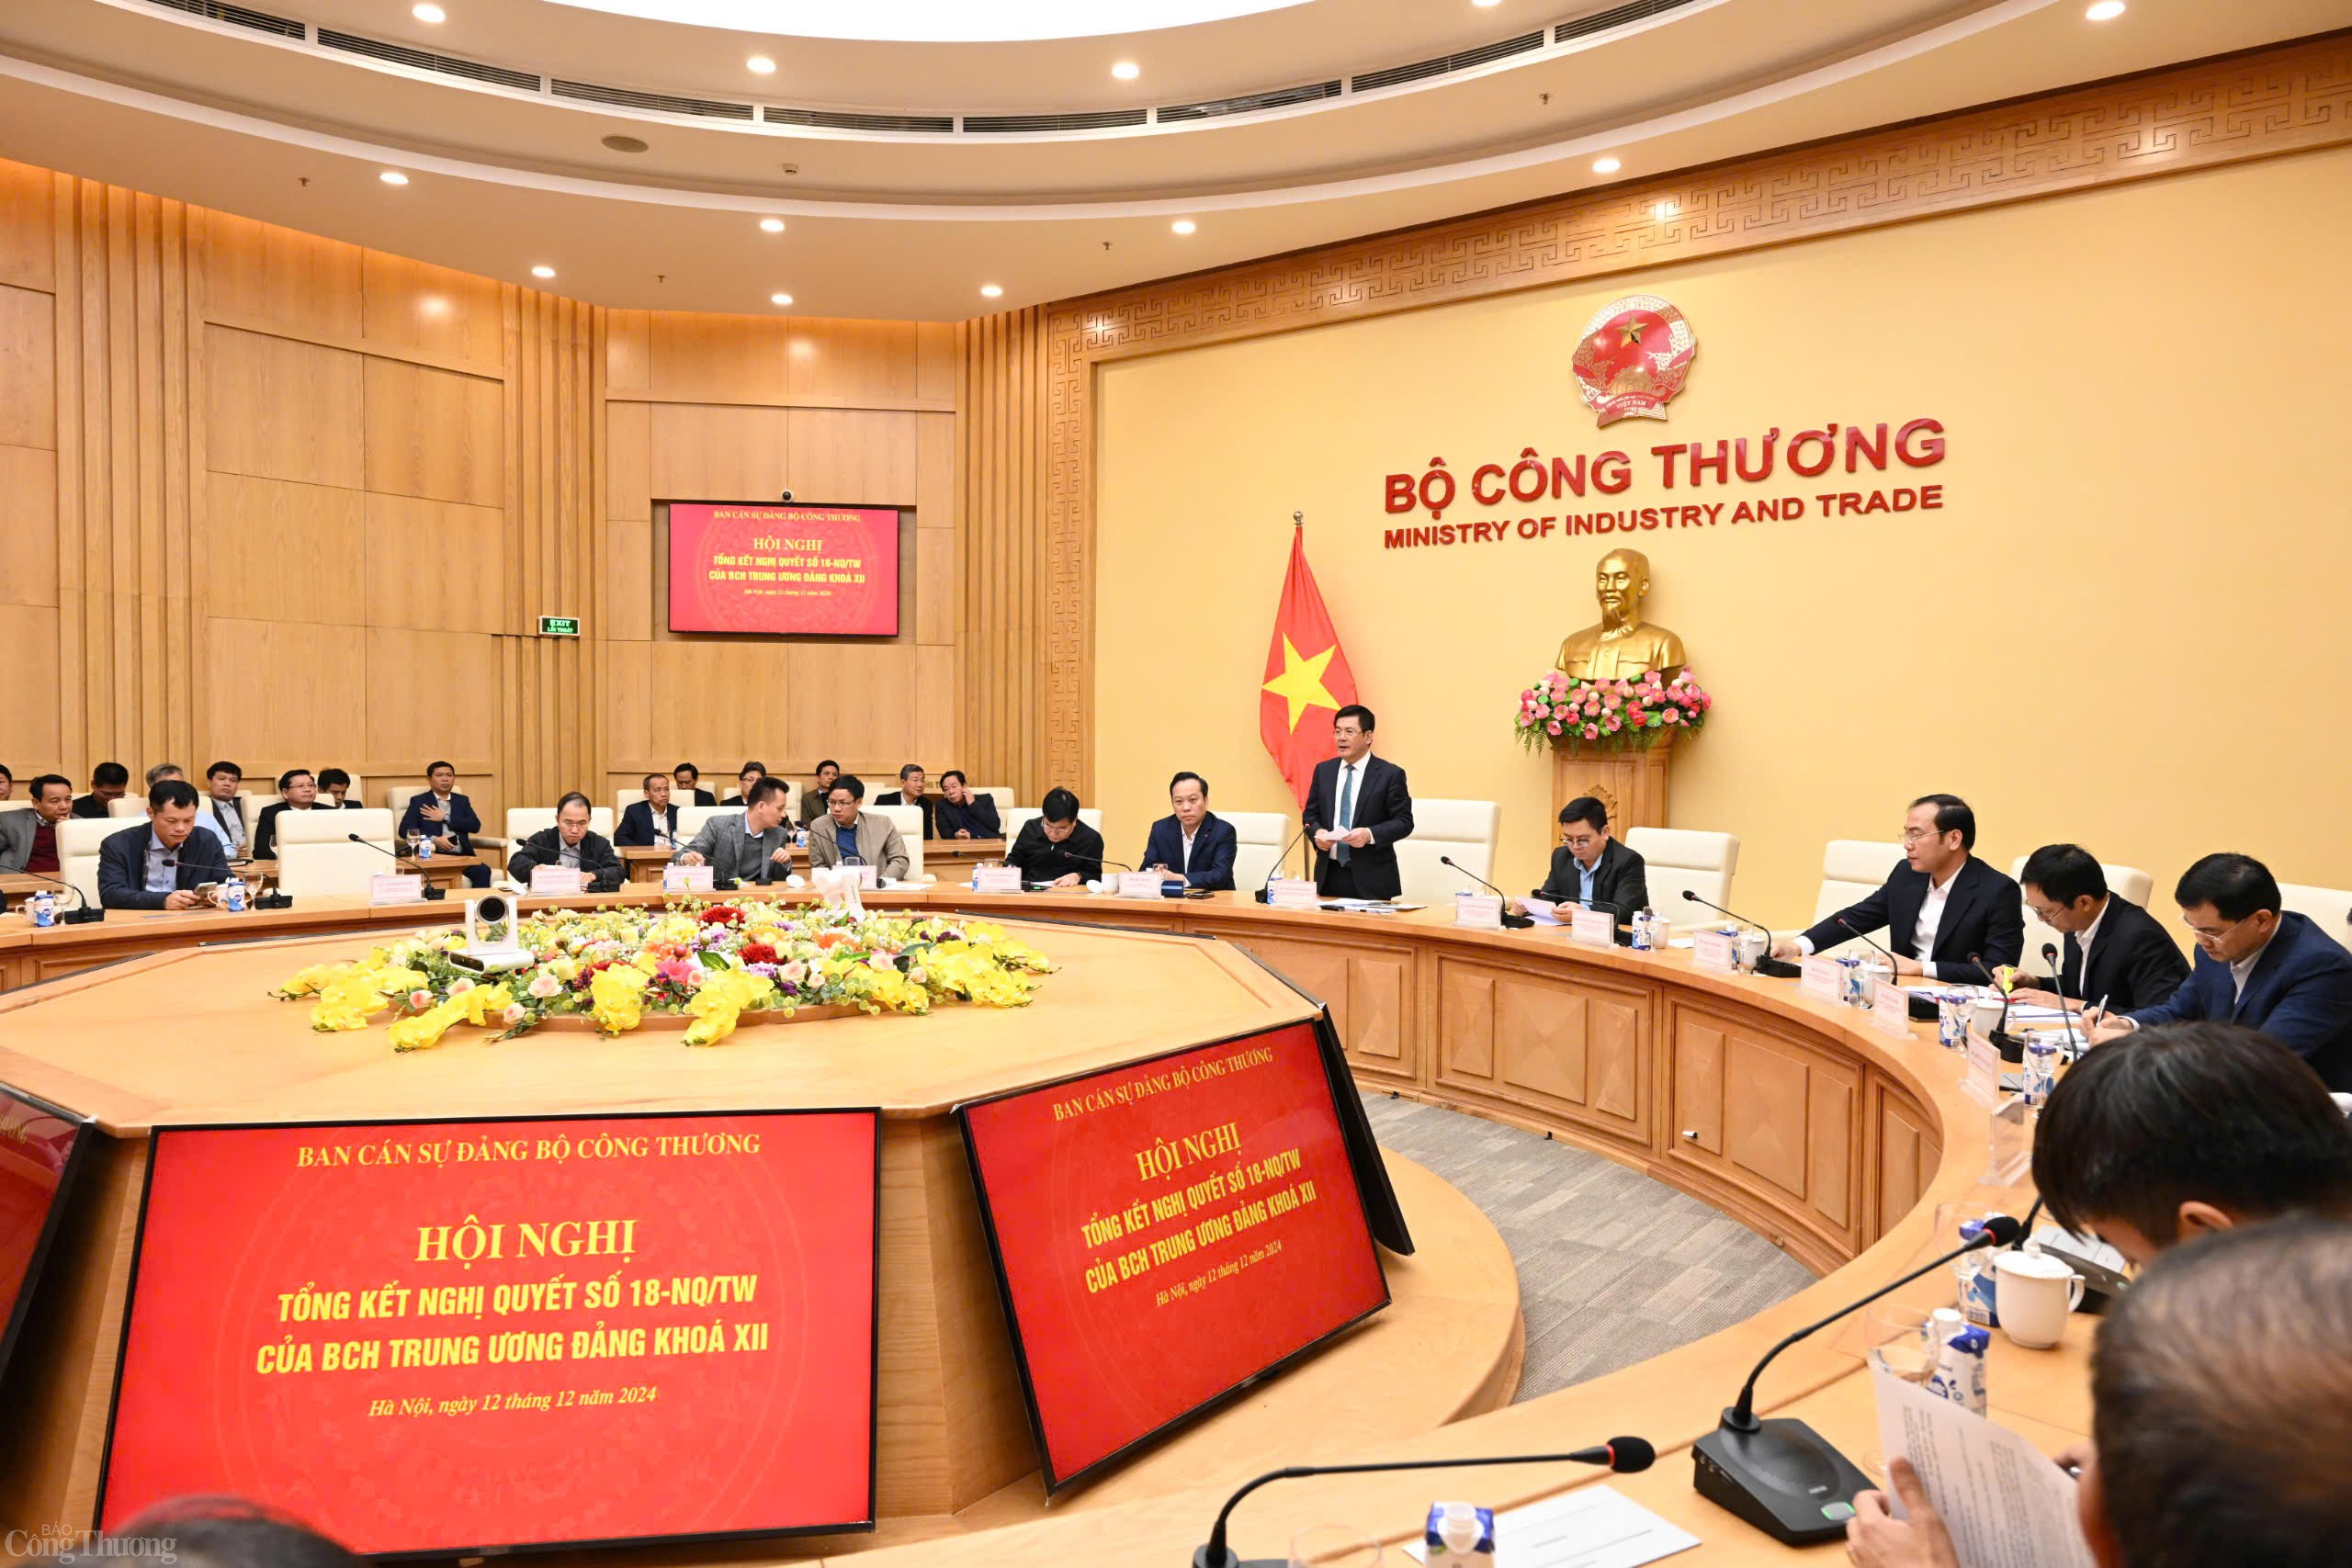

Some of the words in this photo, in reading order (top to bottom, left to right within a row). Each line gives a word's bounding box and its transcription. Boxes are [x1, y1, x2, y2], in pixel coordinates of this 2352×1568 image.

[1385, 457, 1455, 519] BỘ
[1471, 446, 1632, 505] CÔNG
[1650, 418, 1945, 488] THƯƠNG
[1384, 520, 1510, 548] MINISTRY
[1517, 515, 1556, 538] OF
[1566, 502, 1724, 536] INDUSTRY
[1731, 496, 1804, 523] AND
[1815, 484, 1942, 516] TRADE
[713, 553, 736, 565] TỔNG
[738, 554, 753, 566] KẾT
[755, 557, 776, 567] NGHỊ
[778, 555, 805, 567] QUYẾT
[806, 556, 819, 568] SỐ
[820, 558, 861, 569] 18-NQ/TW
[753, 535, 781, 552] HỘI
[784, 538, 823, 555] NGHỊ
[708, 569, 727, 580] CỦA
[728, 570, 746, 581] BCH
[748, 570, 776, 581] TRUNG
[777, 571, 802, 581] ƯƠNG
[803, 570, 827, 582] ĐẢNG
[829, 573, 852, 583] KHOÁ
[854, 573, 865, 583] XII
[1052, 1097, 1084, 1122] BAN
[1084, 1088, 1114, 1111] CÁN
[1114, 1081, 1133, 1105] SỰ
[1134, 1074, 1171, 1099] ĐẢNG
[1171, 1065, 1191, 1089] BỘ
[1191, 1059, 1226, 1082] CÔNG
[1225, 1047, 1272, 1072] THƯƠNG
[298, 1145, 351, 1167] BAN
[357, 1138, 412, 1166] CÁN
[417, 1139, 452, 1168] SỰ
[457, 1135, 528, 1162] ĐẢNG
[536, 1134, 571, 1165] BỘ
[577, 1133, 648, 1158] CÔNG
[655, 1132, 760, 1156] THƯƠNG
[1135, 1137, 1183, 1181] HỘI
[1182, 1122, 1241, 1165] NGHỊ
[1080, 1213, 1124, 1249] TỔNG
[1122, 1198, 1150, 1234] KẾT
[1150, 1190, 1188, 1223] NGHỊ
[1186, 1170, 1227, 1210] QUYẾT
[1227, 1162, 1246, 1193] SỐ
[1245, 1147, 1301, 1186] 18-NQ/TW
[414, 1213, 505, 1269] HỘI
[515, 1219, 638, 1264] NGHỊ
[1084, 1257, 1119, 1293] CỦA
[1116, 1247, 1150, 1280] BCH
[1148, 1228, 1196, 1266] TRUNG
[1194, 1213, 1234, 1247] ƯƠNG
[1231, 1200, 1268, 1232] ĐẢNG
[1266, 1183, 1300, 1217] KHOÁ
[1298, 1180, 1317, 1204] XII
[277, 1281, 351, 1322] TỔNG
[357, 1280, 412, 1319] KẾT
[417, 1285, 484, 1320] NGHỊ
[492, 1273, 578, 1316] QUYẾT
[583, 1269, 622, 1309] SỐ
[629, 1274, 758, 1307] 18-NQ/TW
[1155, 1290, 1170, 1307] Hà
[1169, 1281, 1189, 1301] Nội,
[1187, 1275, 1206, 1293] ngày
[1207, 1268, 1217, 1283] 12
[1216, 1261, 1239, 1279] tháng
[1238, 1254, 1249, 1269] 12
[1249, 1249, 1265, 1264] năm
[1264, 1239, 1282, 1258] 2024
[256, 1334, 312, 1374] CỦA
[321, 1339, 380, 1371] BCH
[389, 1335, 480, 1368] TRUNG
[488, 1330, 564, 1363] ƯƠNG
[571, 1320, 646, 1359] ĐẢNG
[653, 1318, 725, 1356] KHOÁ
[732, 1322, 768, 1352] XII
[368, 1399, 395, 1416] Hà
[398, 1397, 434, 1417] Nội,
[437, 1395, 478, 1416] ngày
[481, 1393, 502, 1411] 12
[504, 1392, 552, 1412] tháng
[556, 1389, 575, 1407] 12
[578, 1389, 615, 1405] năm
[616, 1385, 657, 1404] 2024
